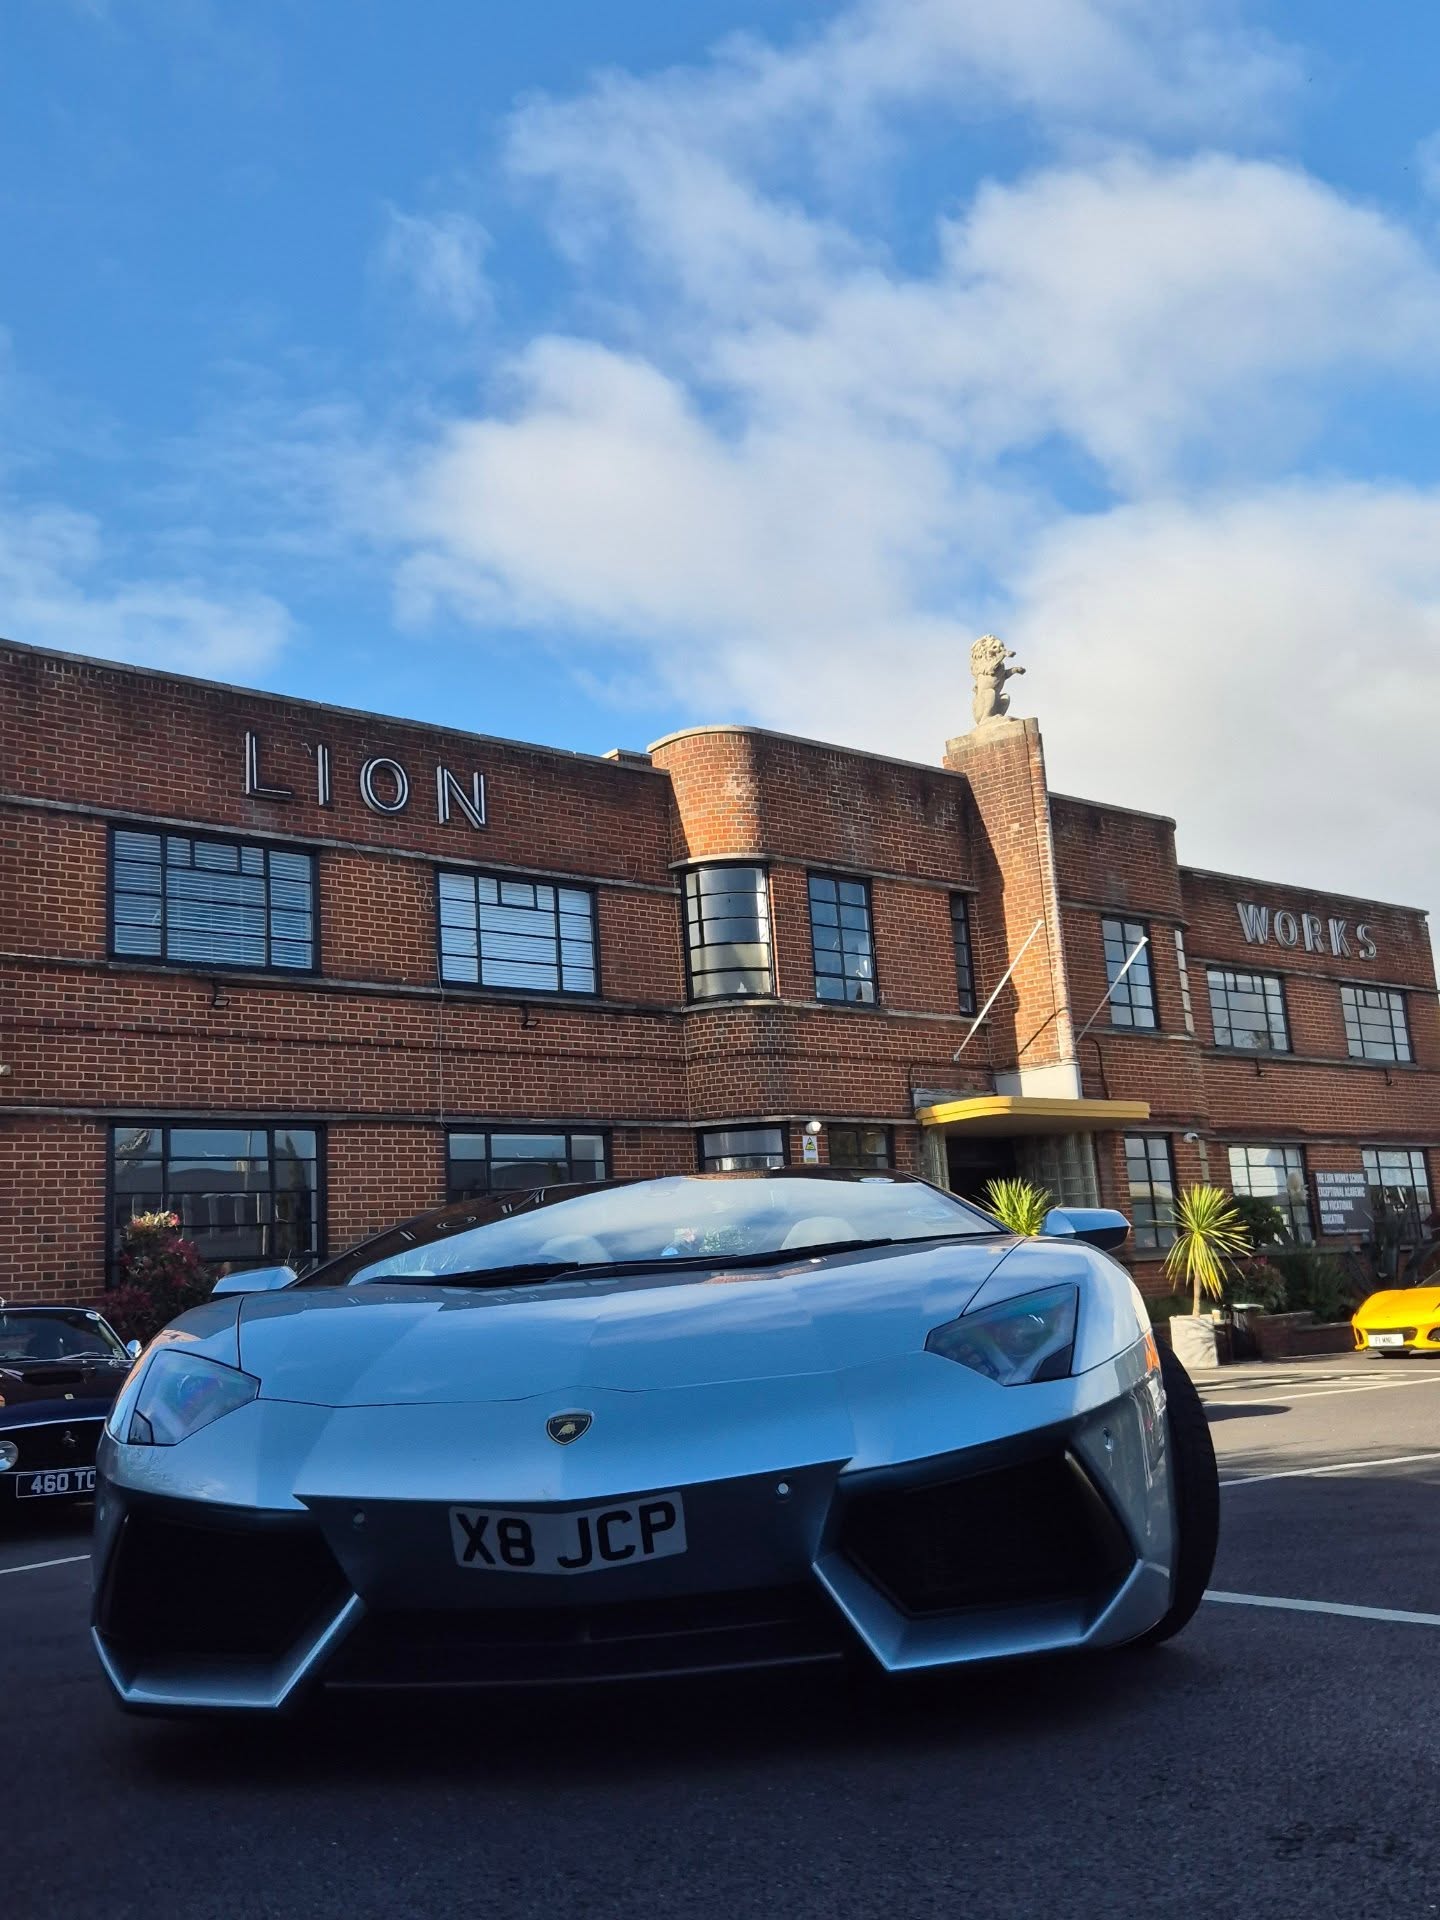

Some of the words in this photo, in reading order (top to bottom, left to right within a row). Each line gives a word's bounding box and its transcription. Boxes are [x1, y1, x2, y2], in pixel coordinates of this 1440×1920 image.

[245, 731, 487, 830] LION
[1236, 902, 1377, 961] WORKS
[31, 1473, 69, 1494] 460
[456, 1513, 536, 1567] X8
[557, 1501, 677, 1569] JCP
